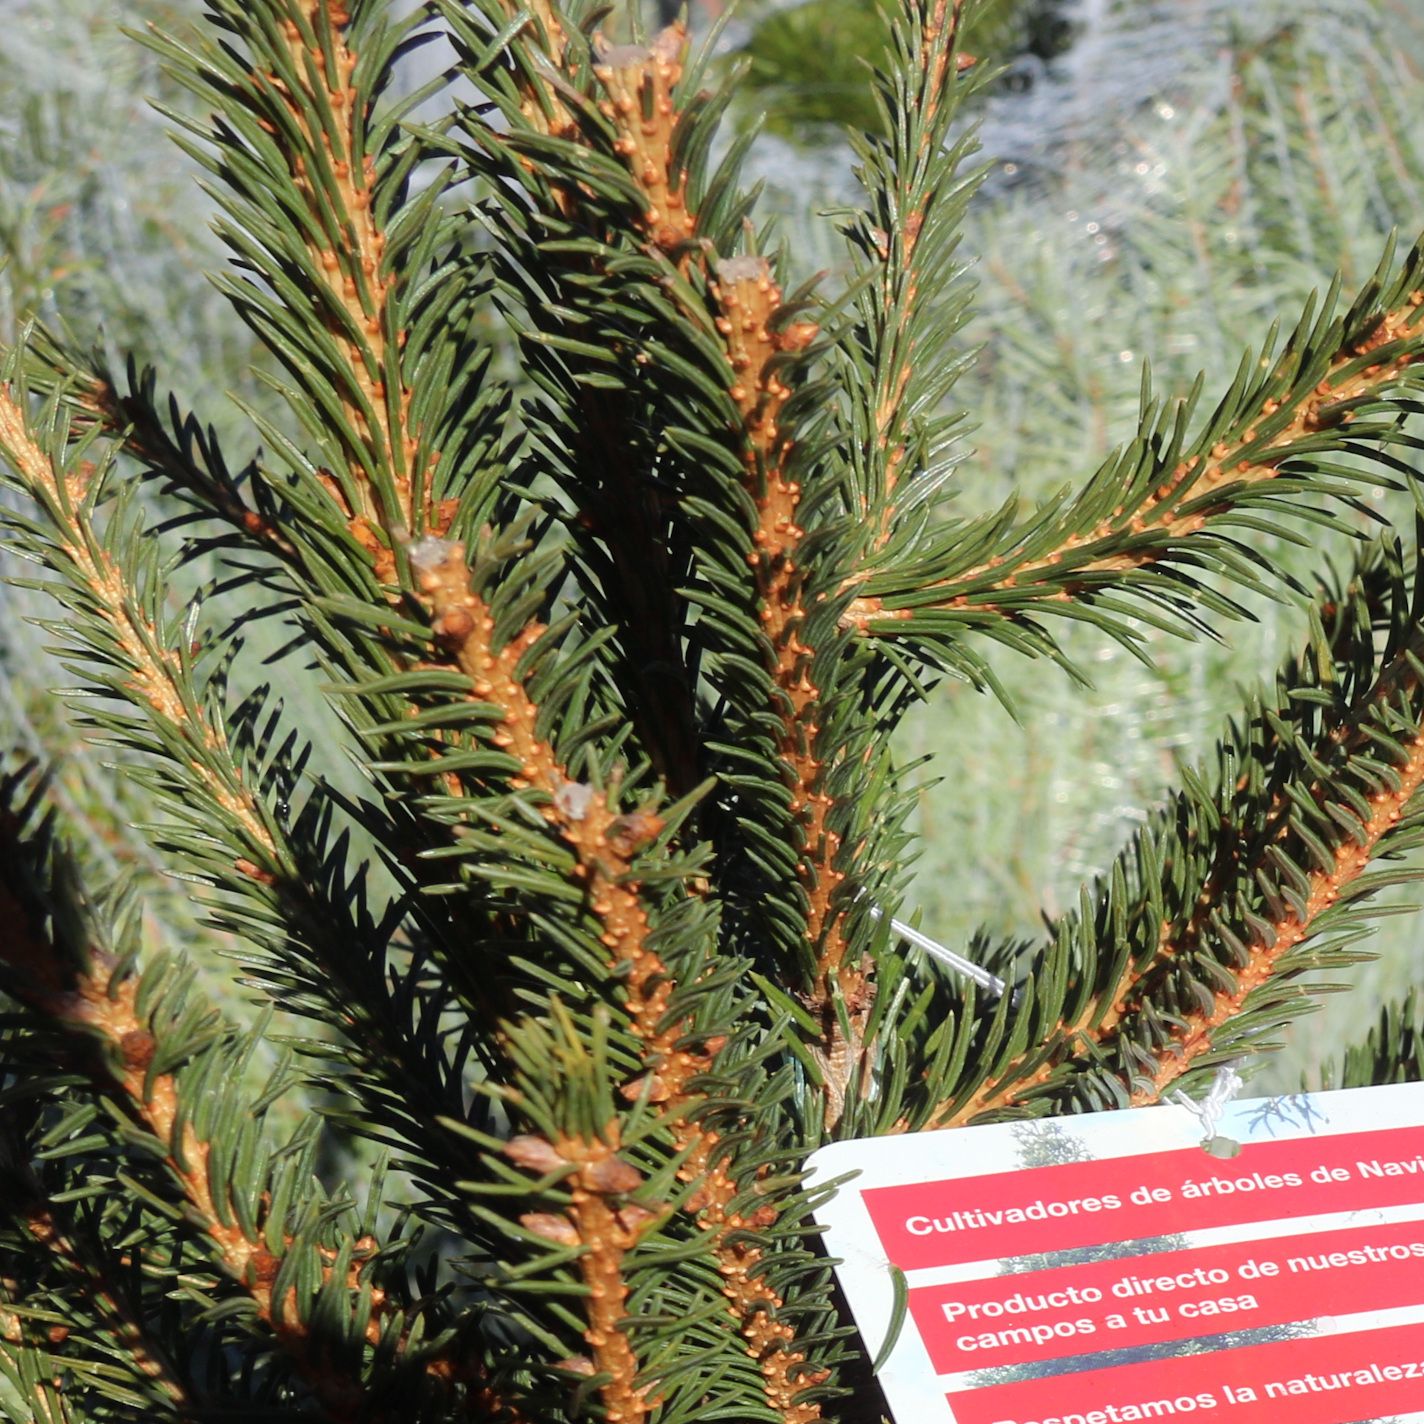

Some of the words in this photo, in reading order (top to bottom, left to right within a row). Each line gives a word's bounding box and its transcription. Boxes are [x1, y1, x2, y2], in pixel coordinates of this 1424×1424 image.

[905, 1194, 1122, 1236] Cultivadores
[1130, 1185, 1172, 1206] de
[1181, 1172, 1304, 1199] árboles
[1311, 1165, 1351, 1184] de
[940, 1286, 1103, 1323] Producto
[1112, 1267, 1230, 1298] directo
[1237, 1259, 1280, 1280] de
[956, 1318, 1097, 1352] campos
[1105, 1313, 1128, 1330] a
[1132, 1306, 1171, 1325] tu
[1179, 1294, 1259, 1318] casa
[1223, 1385, 1258, 1405] la
